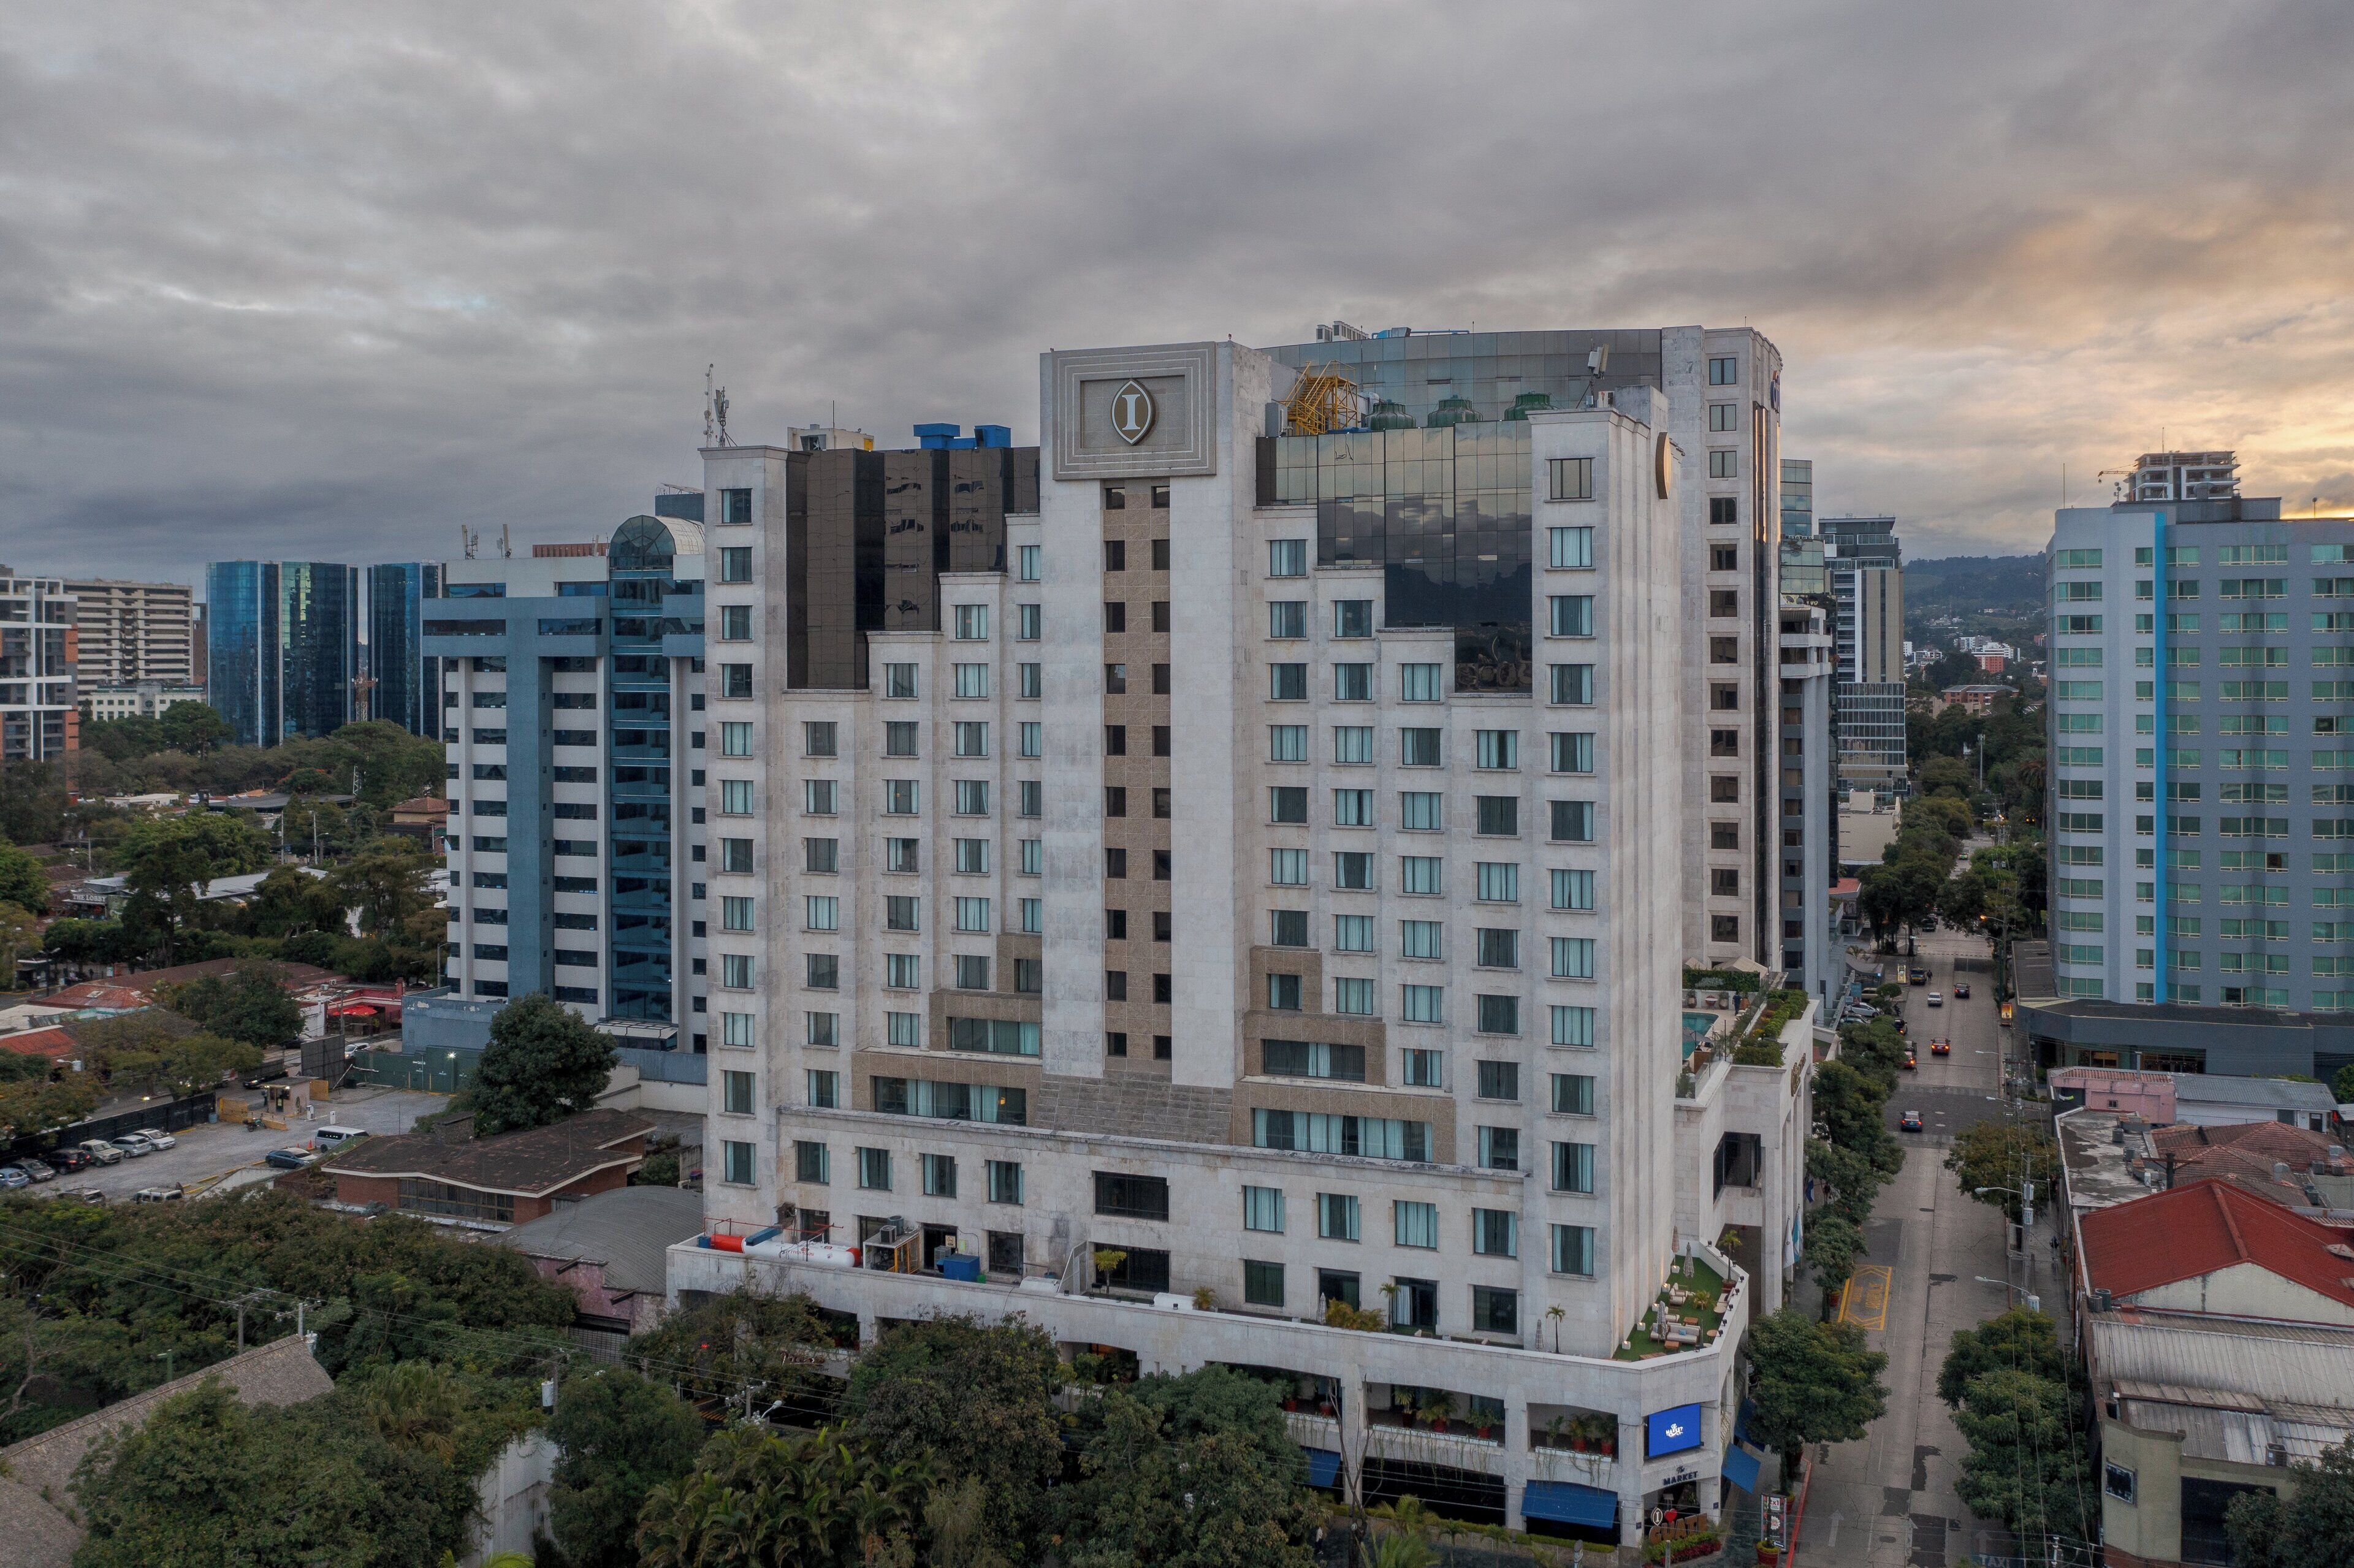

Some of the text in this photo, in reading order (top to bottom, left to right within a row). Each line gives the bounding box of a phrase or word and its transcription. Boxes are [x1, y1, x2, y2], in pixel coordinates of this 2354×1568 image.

[1121, 394, 1141, 430] I
[1666, 1426, 1683, 1436] MARKET
[1663, 1471, 1698, 1486] MARKET
